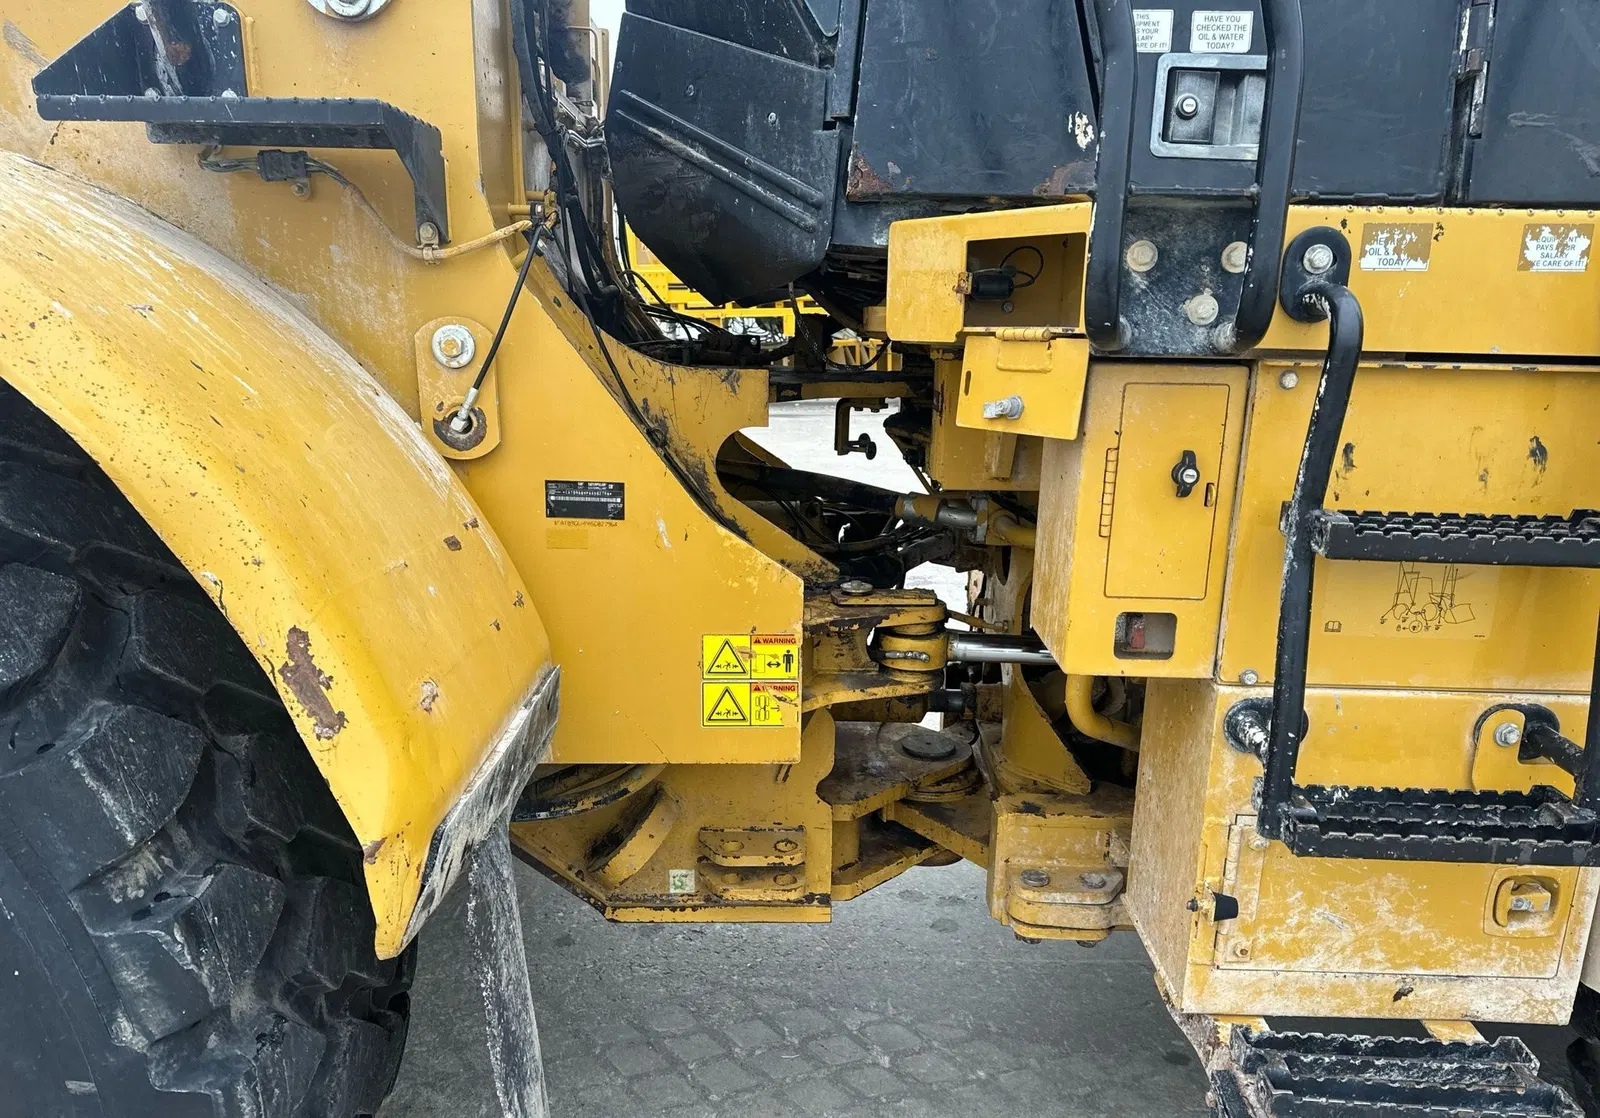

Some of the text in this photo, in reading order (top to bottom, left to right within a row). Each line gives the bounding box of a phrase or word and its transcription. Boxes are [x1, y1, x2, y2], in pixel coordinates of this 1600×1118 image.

[1206, 42, 1235, 50] TODAY?
[1368, 248, 1382, 256] OIL
[1384, 248, 1390, 256] &
[1378, 258, 1411, 266] TODAY?
